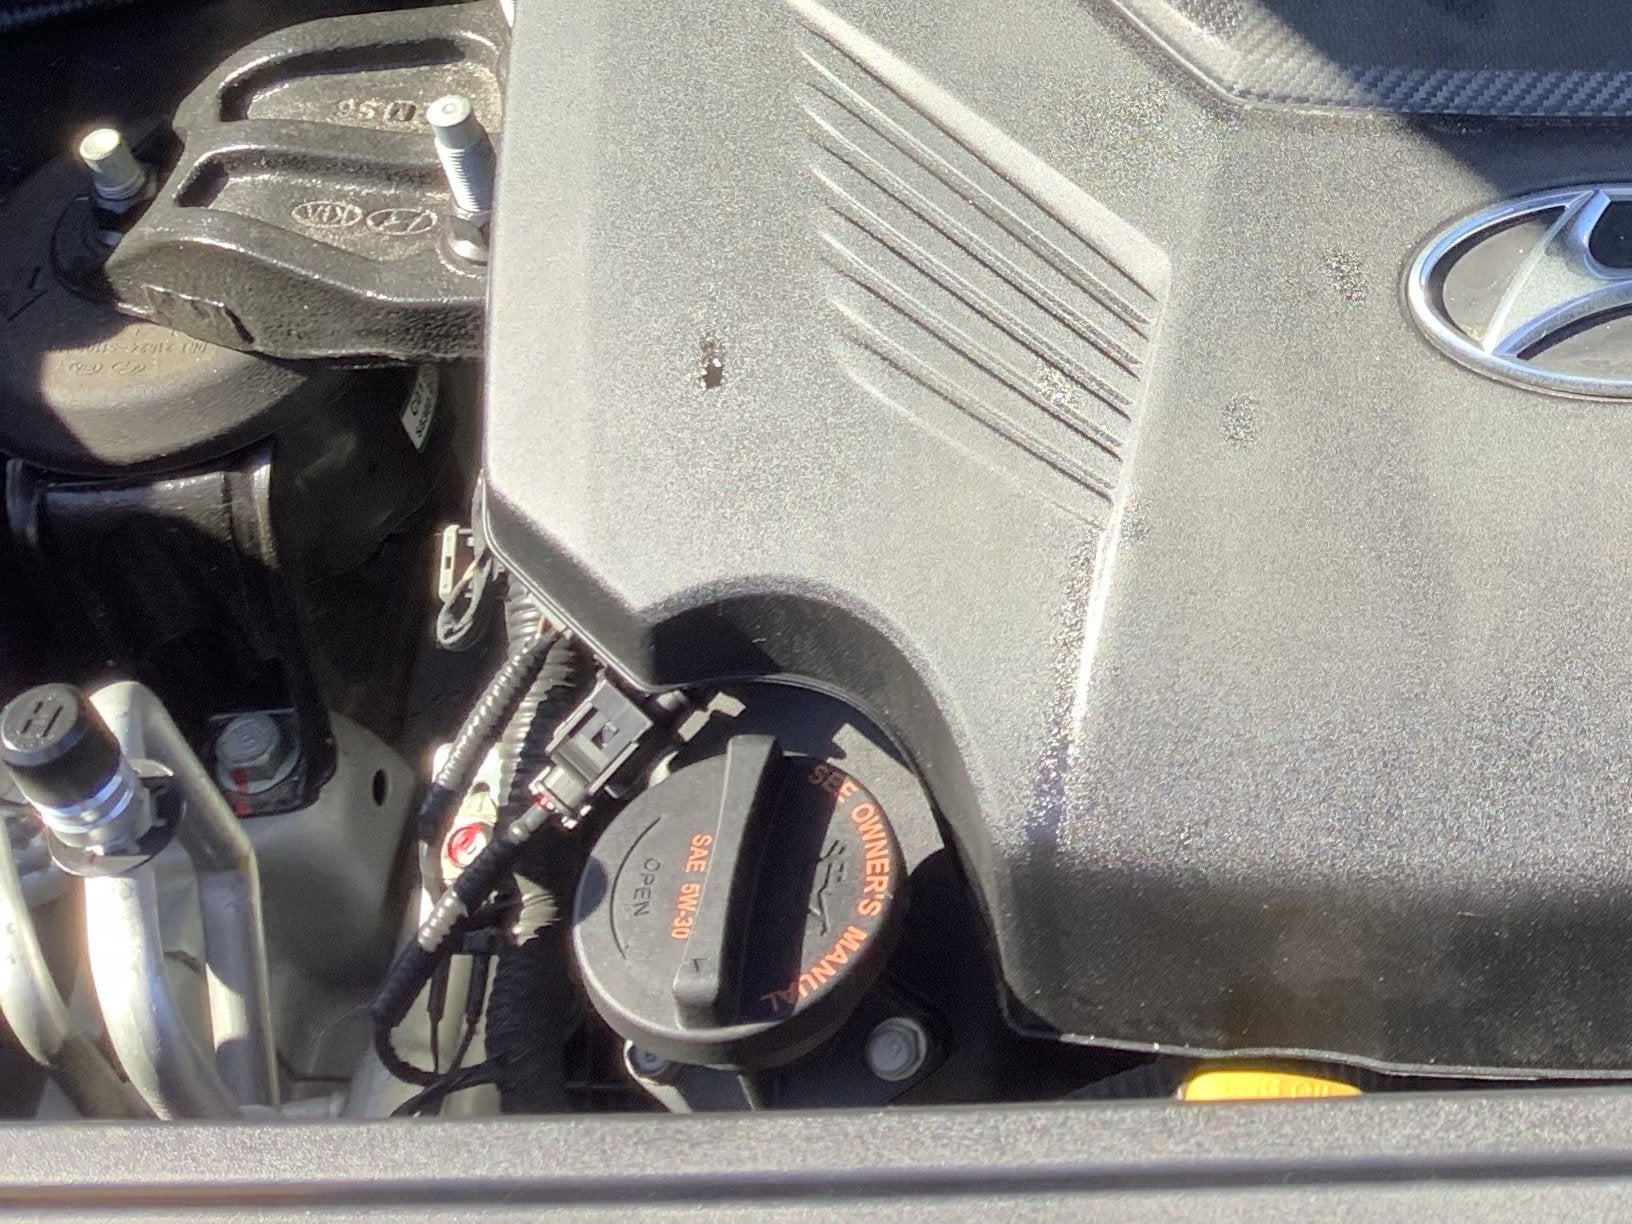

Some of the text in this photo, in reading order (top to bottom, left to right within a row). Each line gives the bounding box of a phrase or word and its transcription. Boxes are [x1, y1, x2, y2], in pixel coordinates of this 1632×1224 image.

[632, 857, 662, 917] OPEN
[671, 833, 713, 939] SAE 5W-30
[758, 764, 890, 1012] SEE OWNER'S MANUAL
